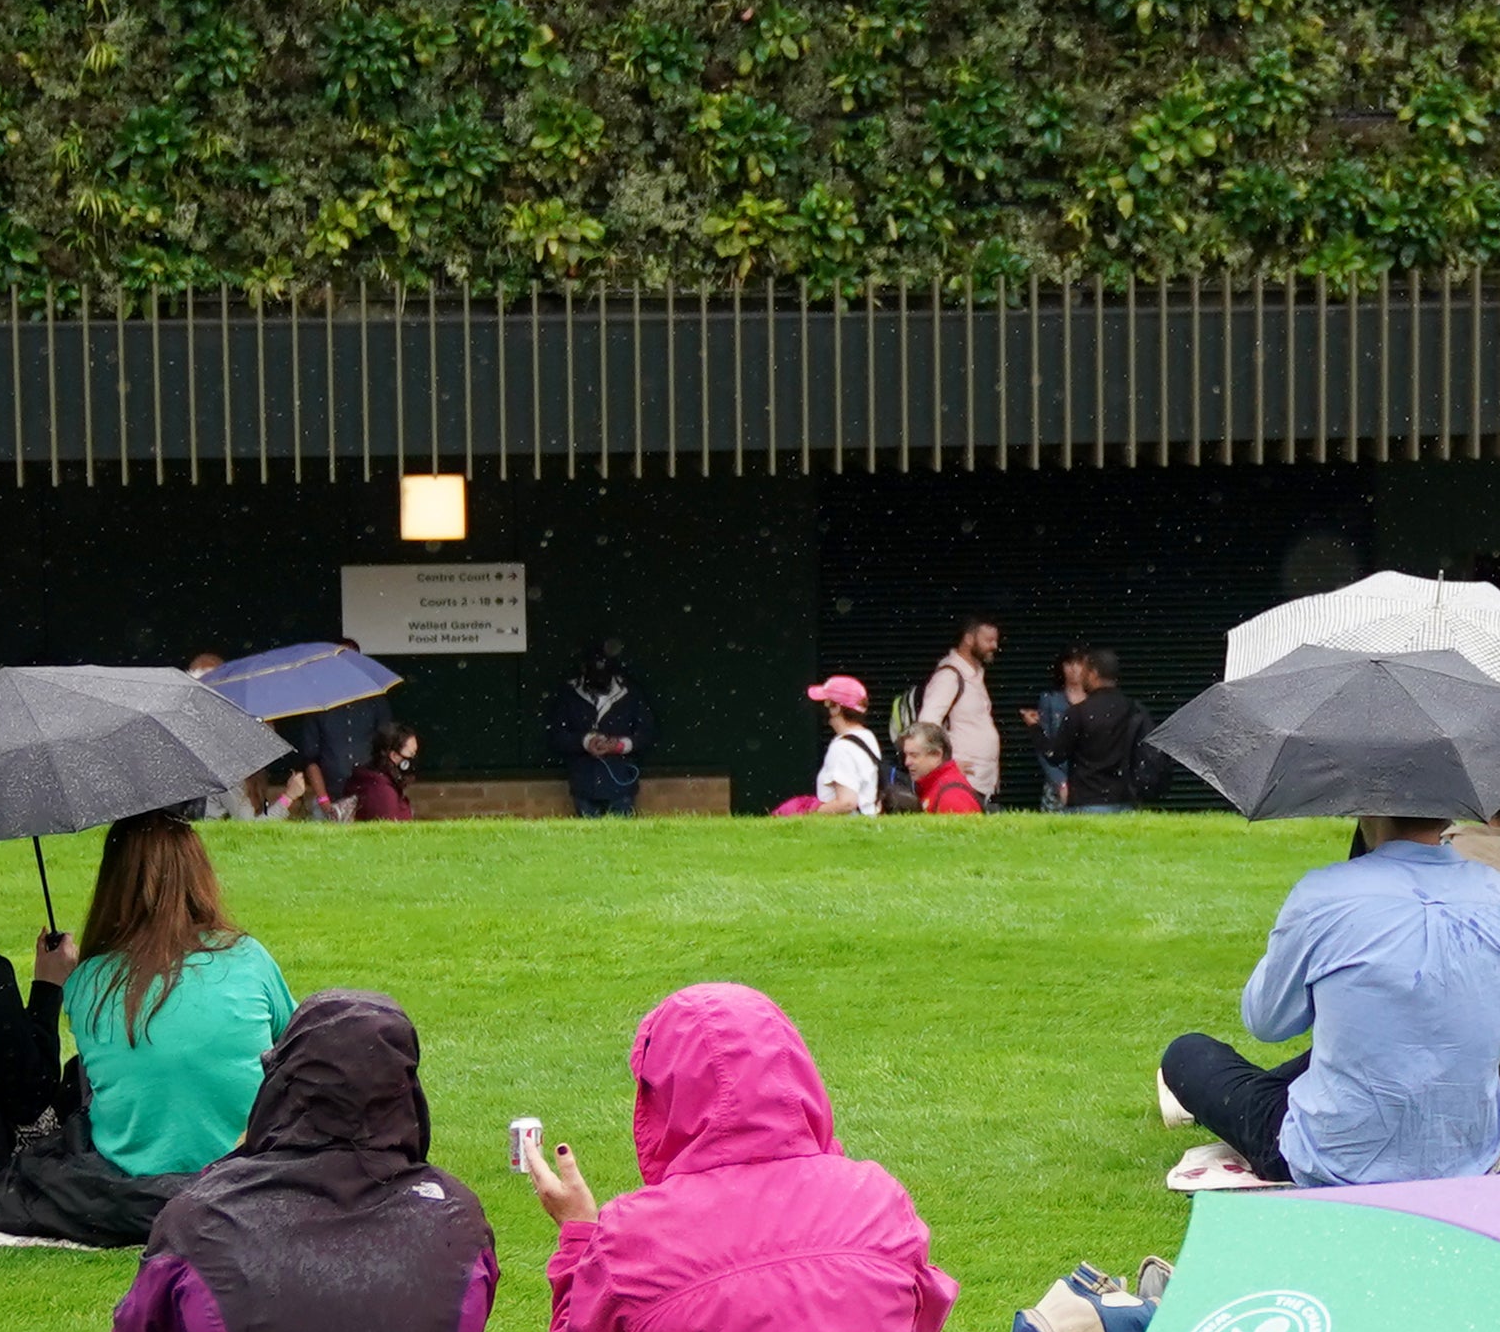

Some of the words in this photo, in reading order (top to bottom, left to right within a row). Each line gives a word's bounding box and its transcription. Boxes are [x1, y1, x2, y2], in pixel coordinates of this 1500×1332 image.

[417, 573, 455, 582] Centre
[458, 572, 490, 581] Court
[420, 597, 457, 607] Courts
[461, 597, 468, 606] 2
[408, 620, 447, 630] Walled
[451, 620, 492, 629] Garden
[408, 634, 438, 643] Food
[441, 634, 479, 643] Market
[1275, 1296, 1306, 1312] THE
